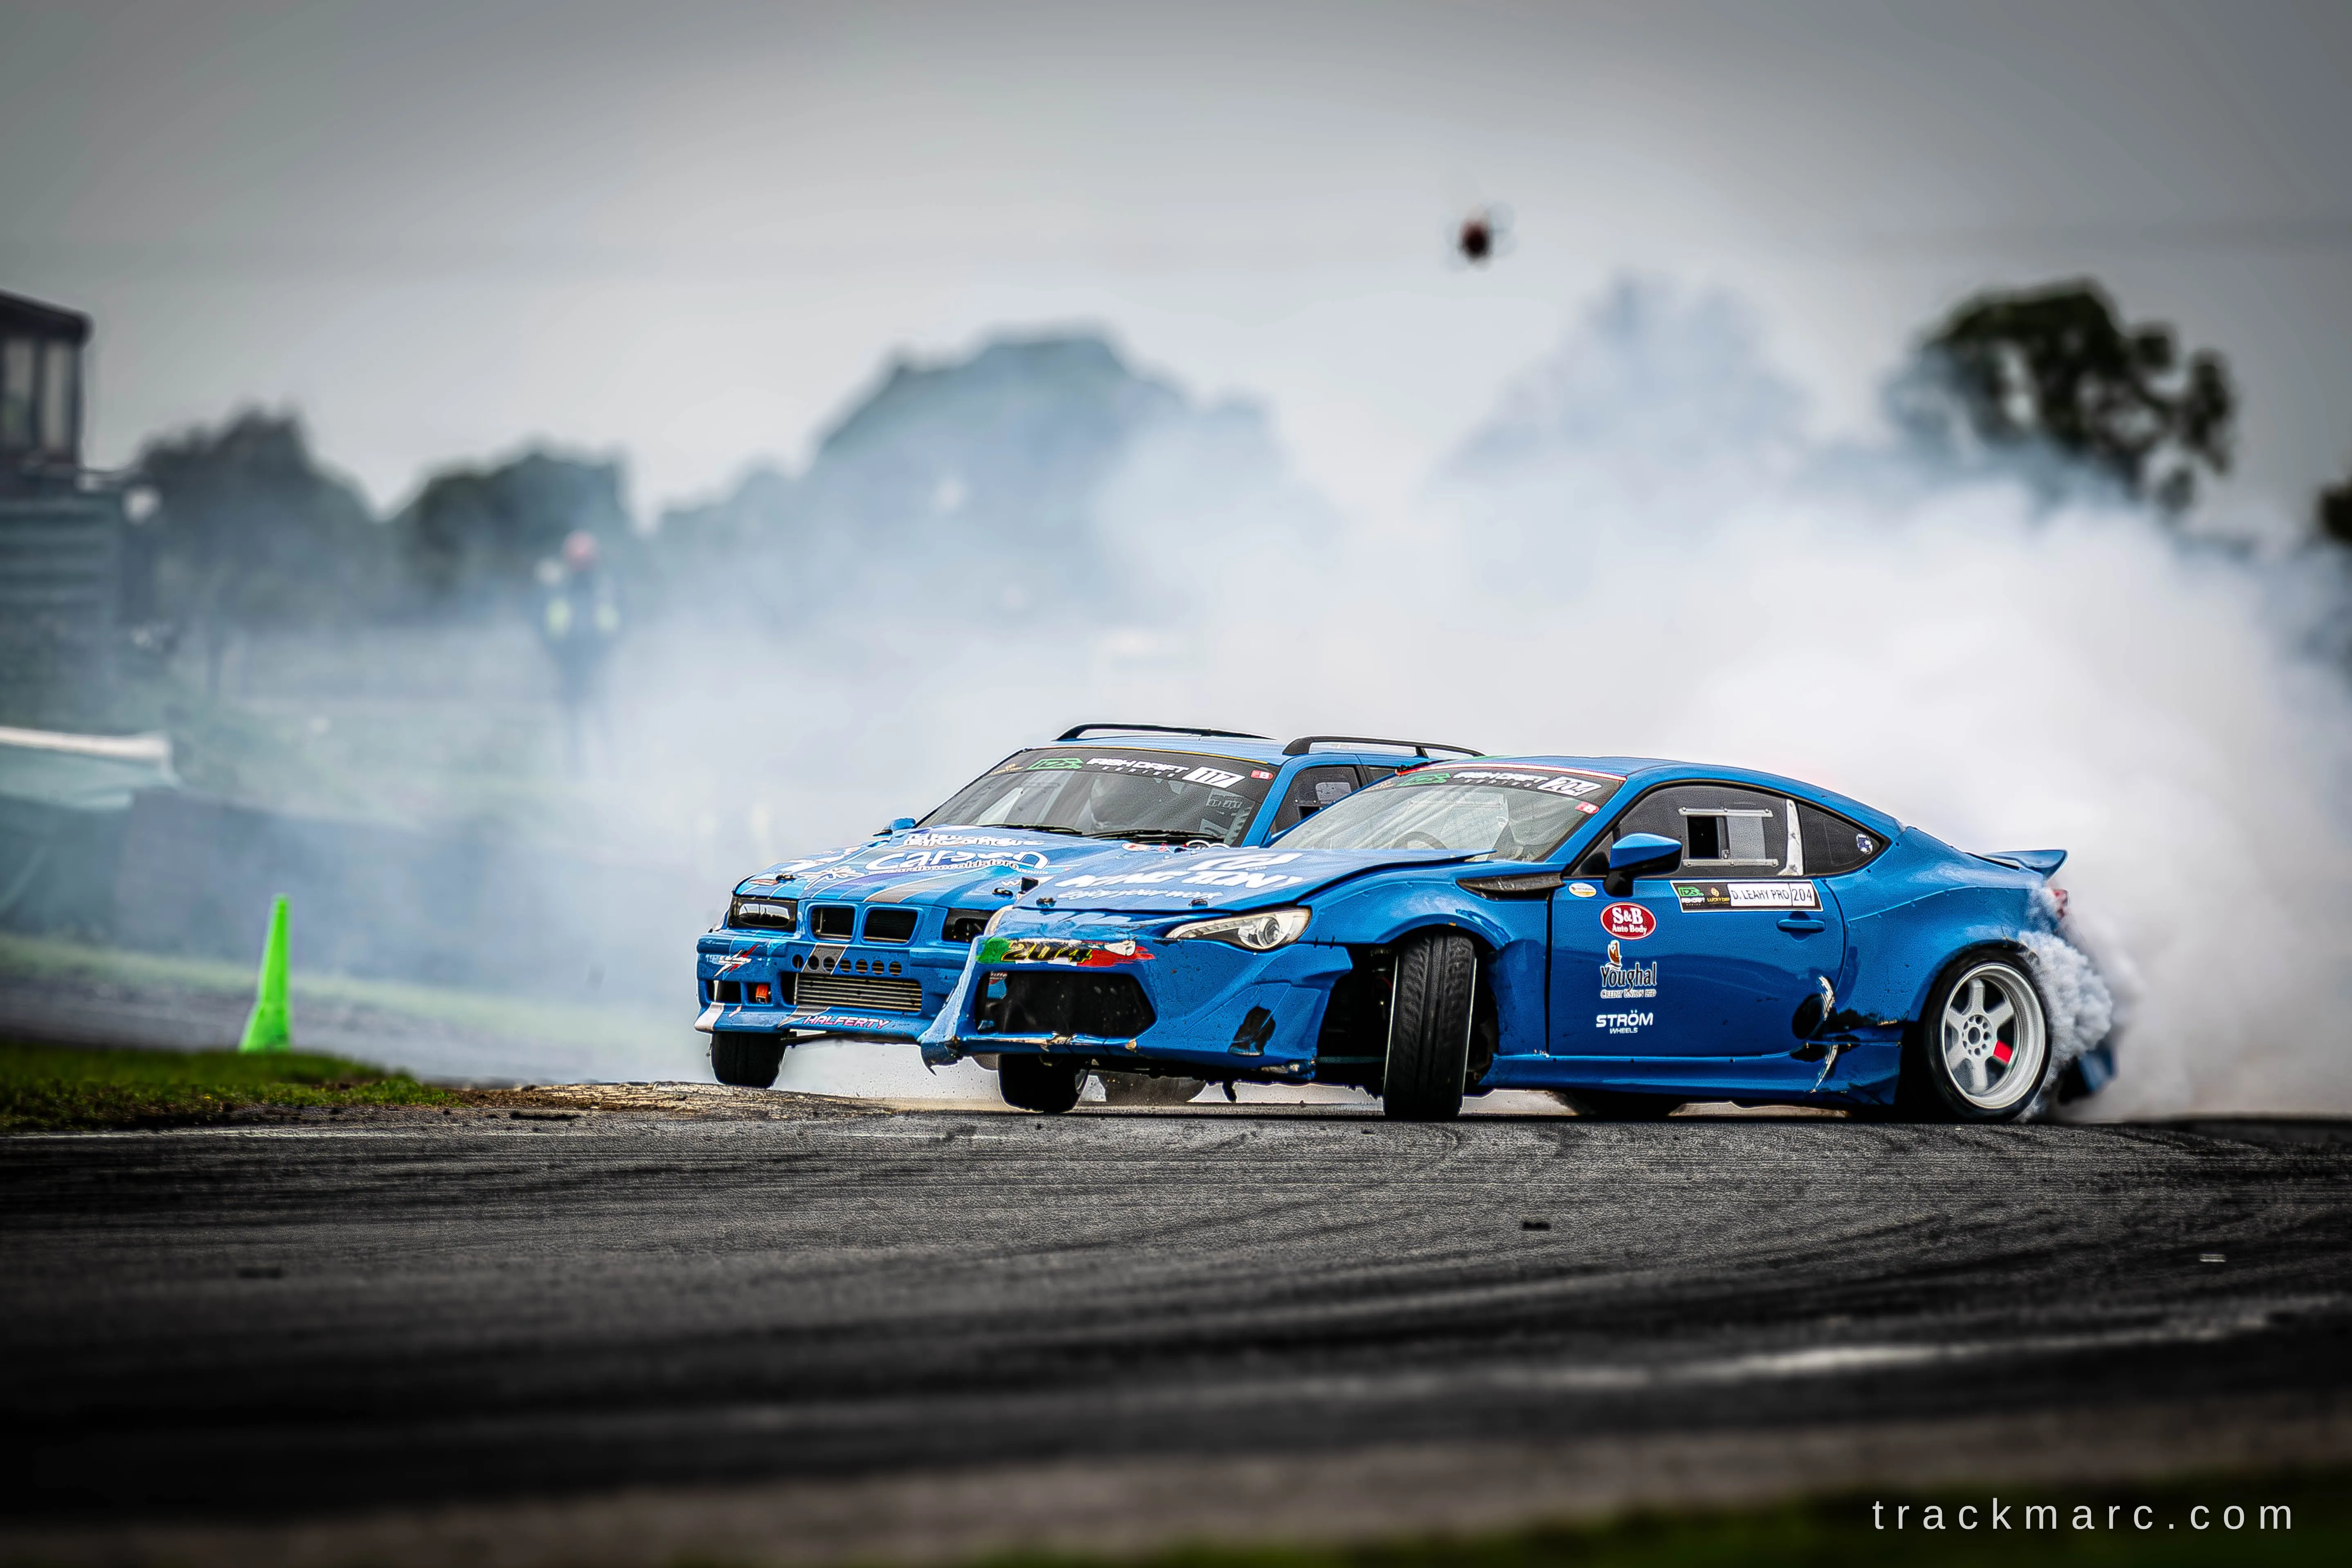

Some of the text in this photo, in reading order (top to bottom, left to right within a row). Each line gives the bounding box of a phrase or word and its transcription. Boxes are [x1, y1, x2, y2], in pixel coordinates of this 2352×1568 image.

[1133, 761, 1189, 773] DRIFT
[1194, 770, 1237, 784] 117
[1544, 780, 1595, 793] 204
[1731, 890, 1741, 900] D.
[1743, 890, 1769, 900] LEAHY
[1772, 890, 1789, 900] PRO
[1792, 888, 1812, 902] 204
[1612, 906, 1643, 924] S&B
[1612, 923, 1647, 935] Auto Body
[1600, 962, 1656, 992] Youghal
[1601, 990, 1623, 998] CREDIT
[803, 1015, 890, 1029] HALFERTY
[1596, 1009, 1654, 1028] STRÖM
